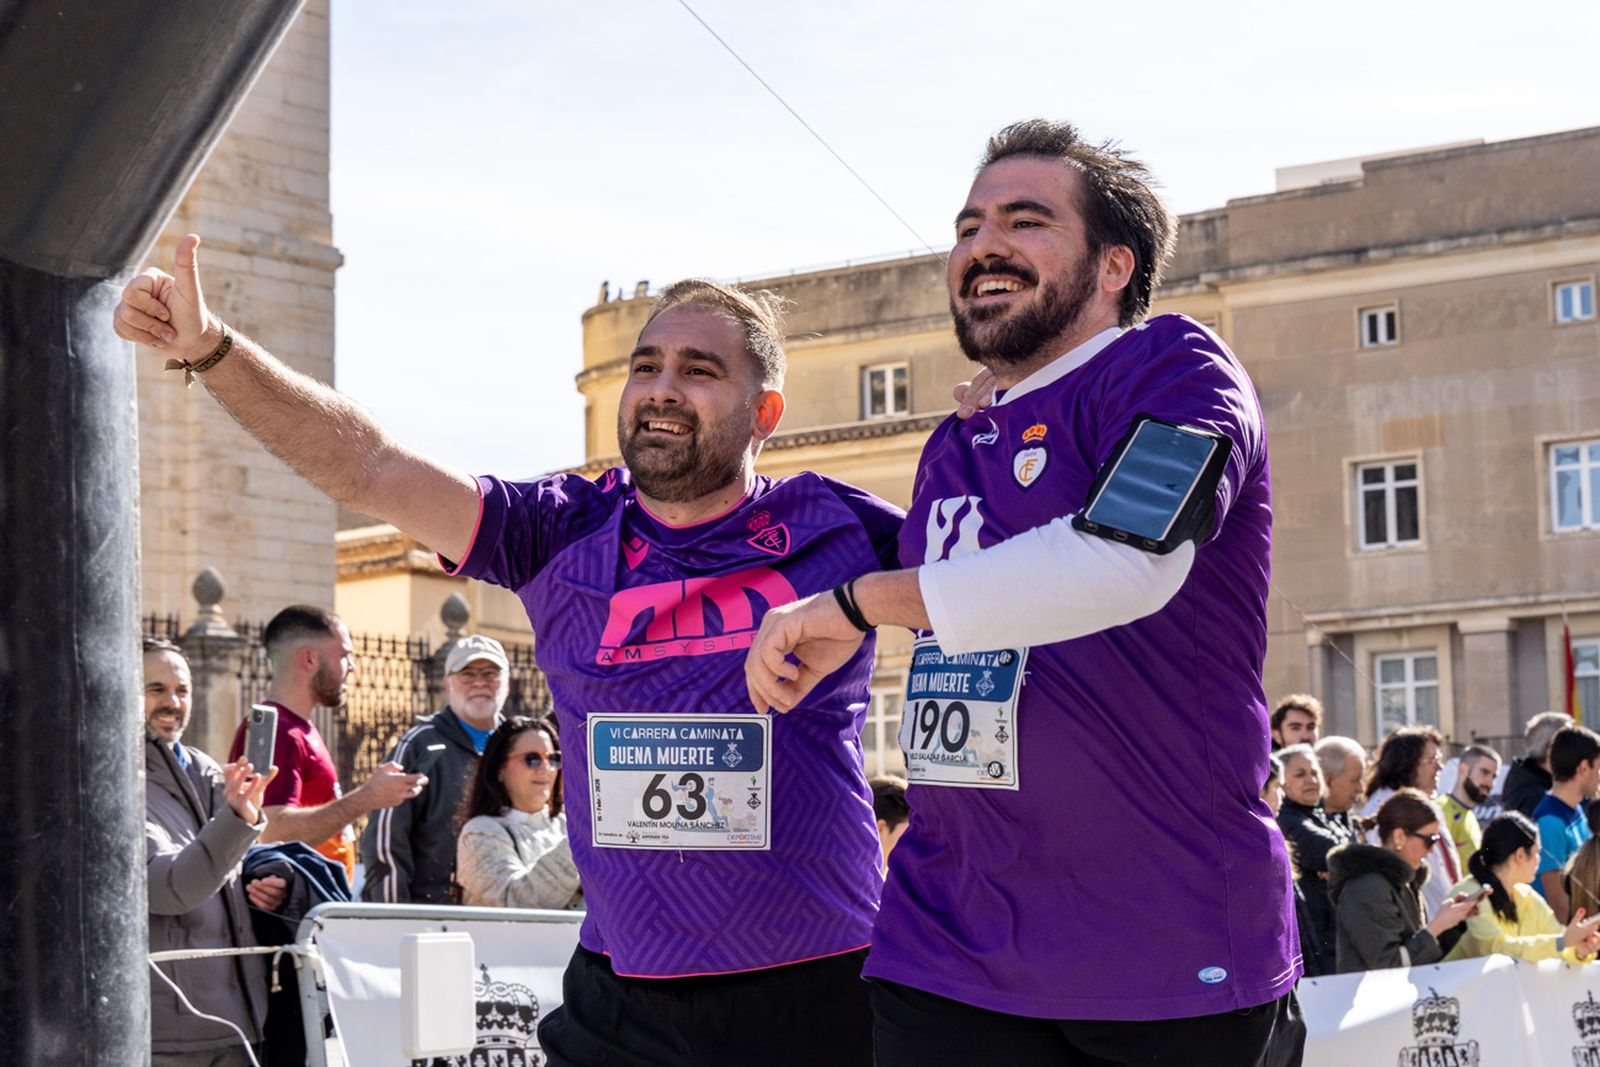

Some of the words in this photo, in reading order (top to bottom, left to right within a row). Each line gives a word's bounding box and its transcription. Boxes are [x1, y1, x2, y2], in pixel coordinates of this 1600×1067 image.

[945, 653, 1000, 668] CAMINATA
[928, 672, 971, 693] MUERTE
[609, 727, 621, 739] VI
[622, 727, 677, 740] CARRERA
[679, 727, 745, 740] CAMINATA
[909, 700, 971, 753] 190
[609, 746, 653, 765] BUENA
[656, 746, 715, 765] MUERTE
[641, 772, 707, 821] 63
